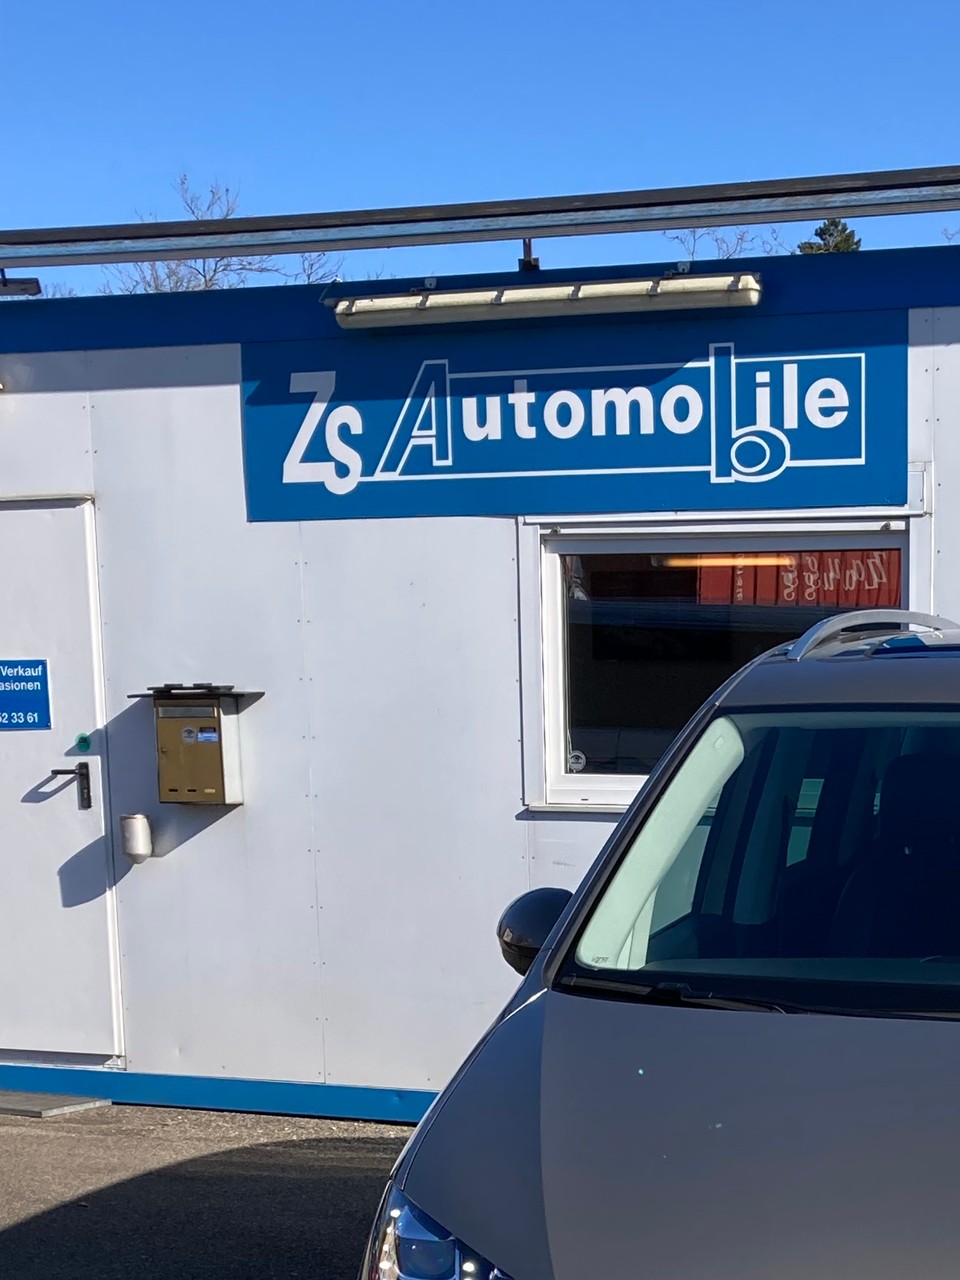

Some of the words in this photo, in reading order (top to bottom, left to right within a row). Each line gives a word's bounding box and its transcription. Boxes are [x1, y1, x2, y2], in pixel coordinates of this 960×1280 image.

[375, 342, 849, 483] Automobile
[11, 712, 24, 723] 33
[27, 712, 38, 723] 61
